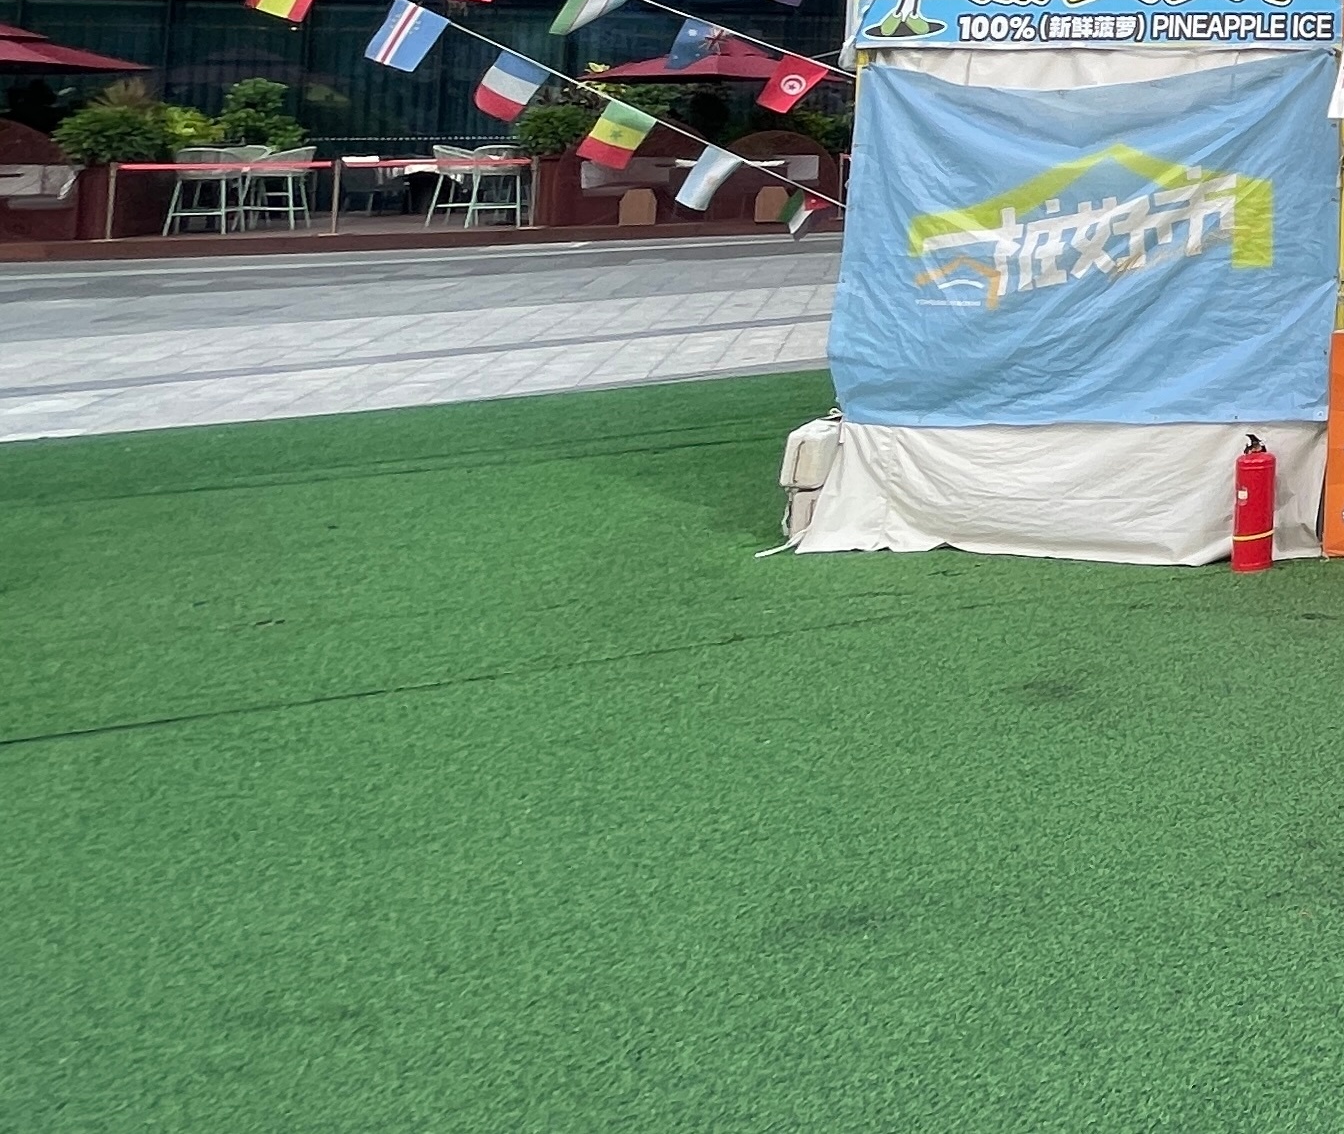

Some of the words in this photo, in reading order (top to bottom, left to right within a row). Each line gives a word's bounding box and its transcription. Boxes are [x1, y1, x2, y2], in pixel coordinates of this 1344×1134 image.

[958, 16, 1035, 40] 100%
[1040, 15, 1144, 40] (新鲜菠萝)
[1152, 15, 1286, 39] PINEAPPLE
[1292, 16, 1333, 39] ICE
